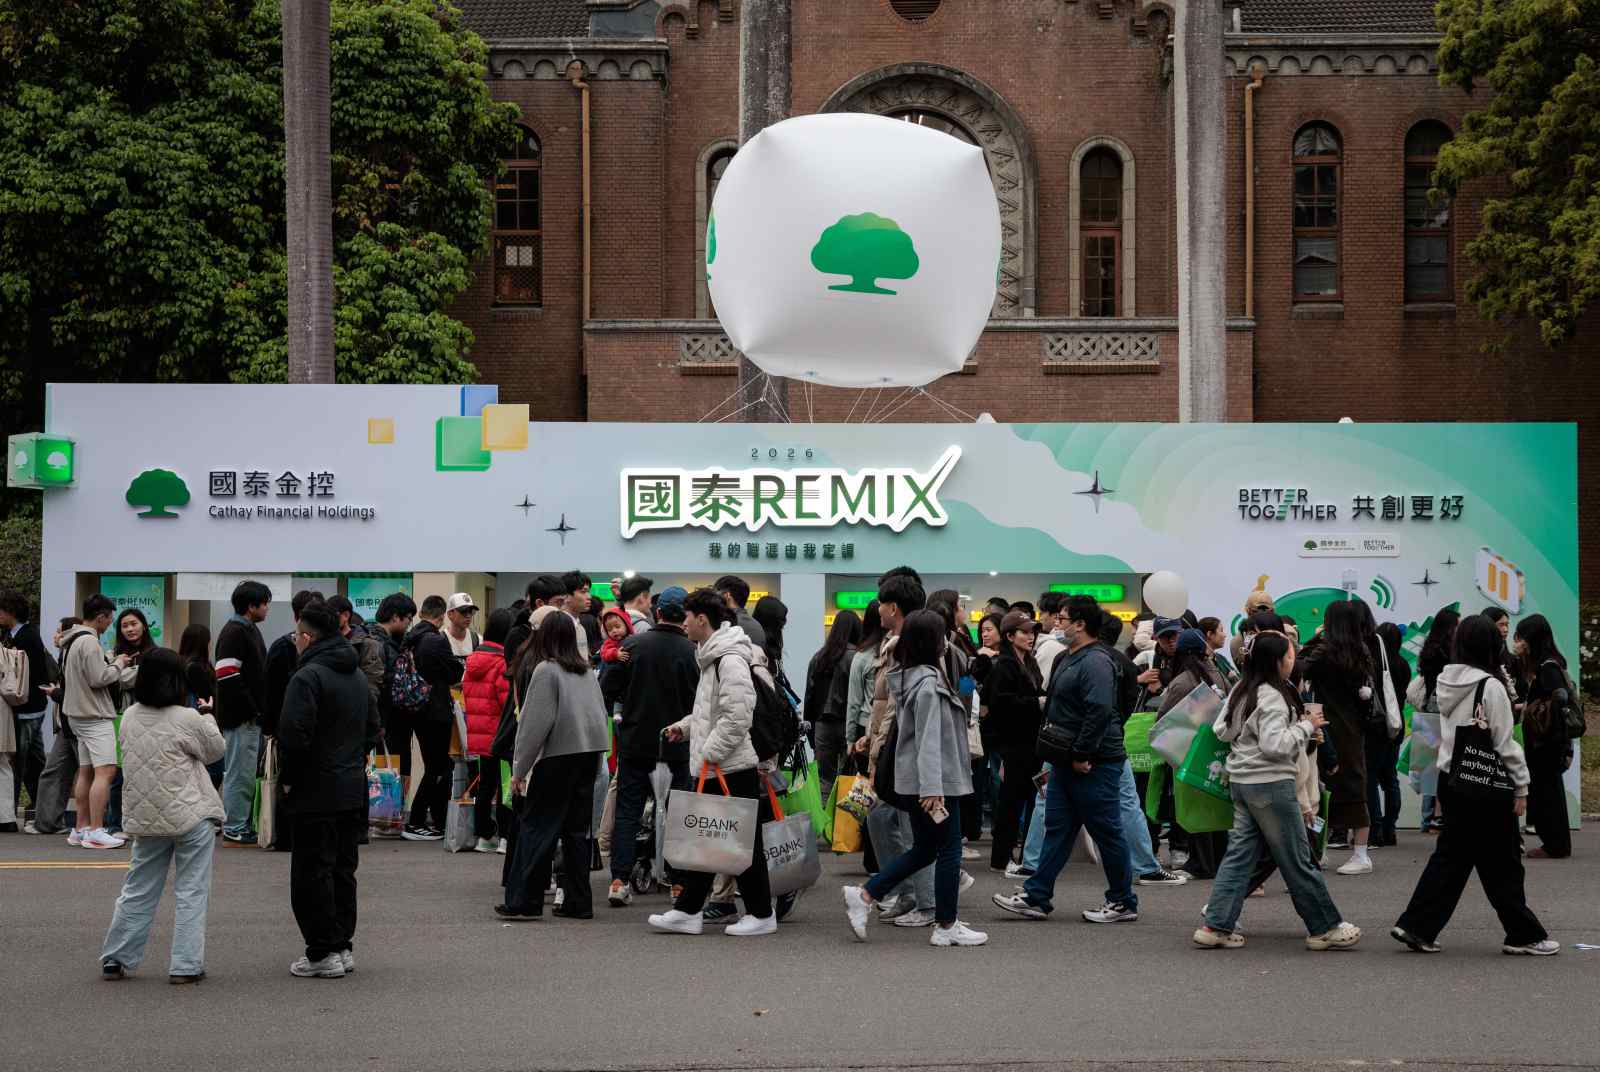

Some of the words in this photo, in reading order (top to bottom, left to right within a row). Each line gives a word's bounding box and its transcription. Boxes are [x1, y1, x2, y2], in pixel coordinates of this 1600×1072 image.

[751, 448, 813, 459] 2026
[209, 471, 335, 497] 國泰金控
[627, 454, 954, 532] 國泰REMIX
[1239, 489, 1309, 503] BETTER
[208, 505, 252, 520] Cathay
[257, 505, 313, 519] Financial
[318, 505, 376, 521] Holdings
[1238, 505, 1337, 521] TOGETHER
[1352, 495, 1464, 521] 共創更好
[1464, 745, 1477, 755] No
[1461, 760, 1495, 775] anybody
